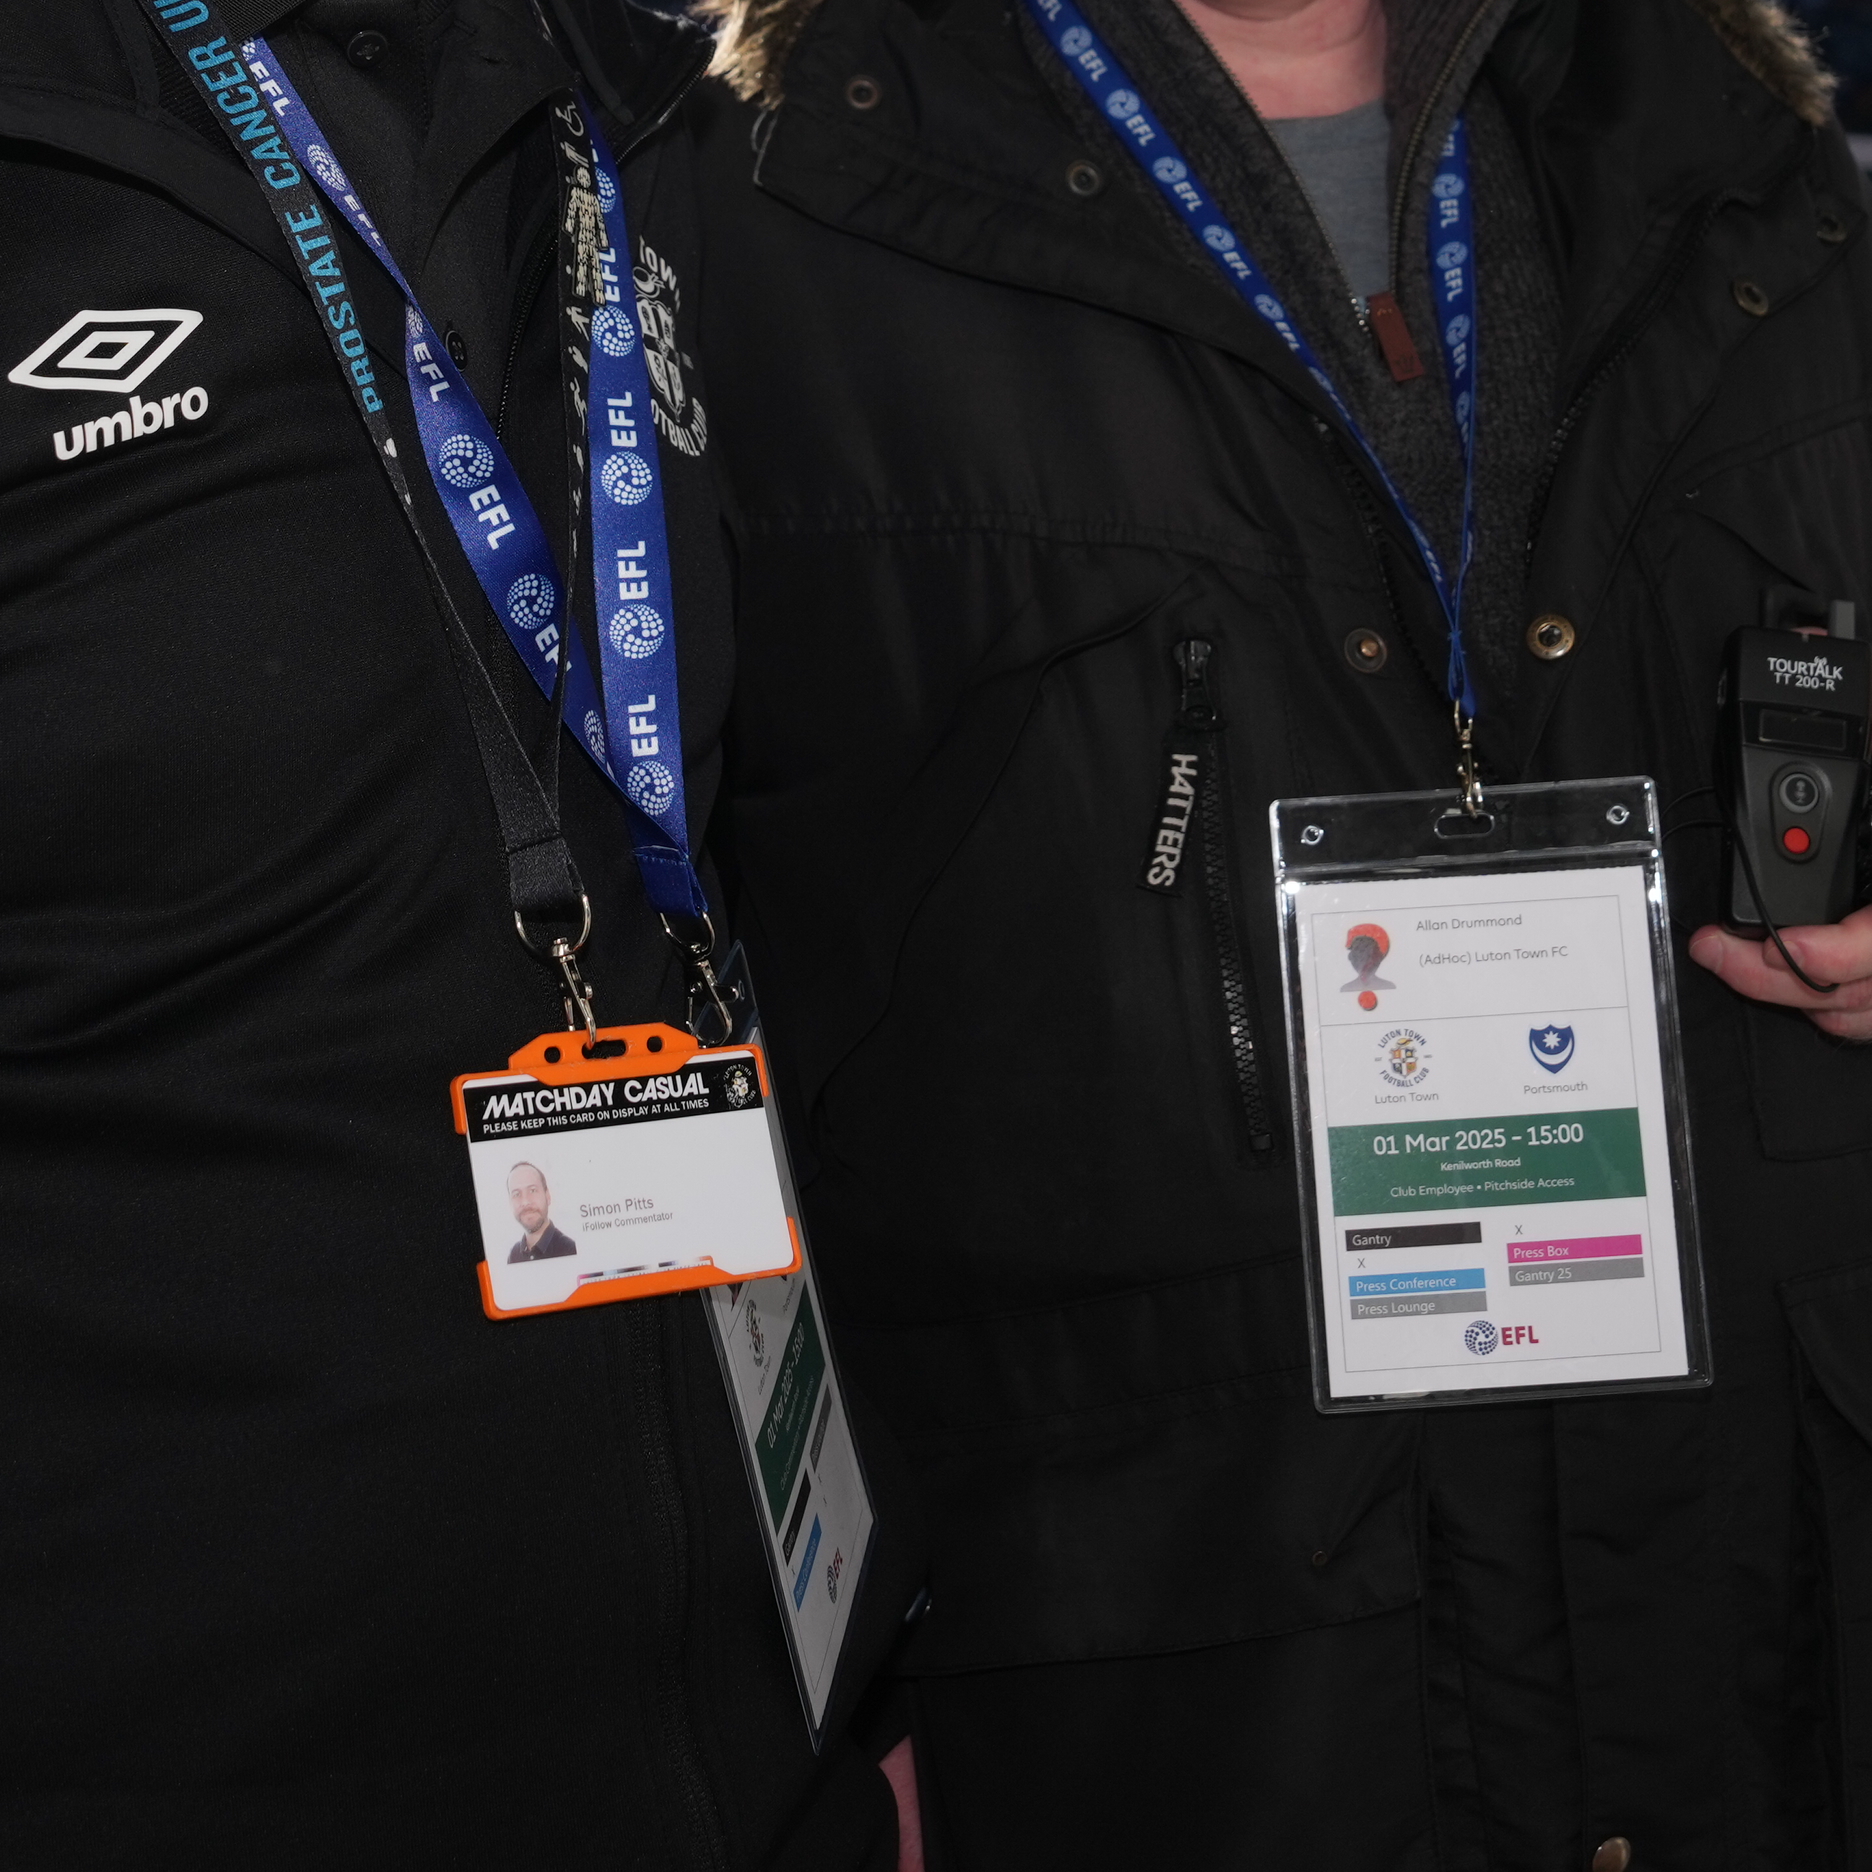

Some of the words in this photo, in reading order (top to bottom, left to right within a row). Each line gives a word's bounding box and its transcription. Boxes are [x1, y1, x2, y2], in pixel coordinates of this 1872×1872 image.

[1078, 48, 1108, 82] EFL
[247, 61, 291, 117] EFL
[187, 35, 302, 190] CANCER
[1125, 114, 1157, 147] EFL
[1173, 181, 1203, 212] EFL
[344, 194, 382, 247] EFL
[1439, 198, 1459, 229] EFL
[1222, 251, 1252, 280] EFL
[1444, 267, 1464, 302] EFL
[285, 203, 384, 413] PROSTATE
[1275, 321, 1300, 351] EFL
[412, 341, 451, 403] EFL
[53, 386, 209, 461] umbro
[607, 391, 638, 448] EFL
[468, 483, 516, 551] EFL
[617, 540, 650, 601] EFL
[535, 623, 572, 678] EF
[1767, 656, 1843, 681] TOURTALK
[1774, 672, 1792, 685] TT
[1795, 675, 1835, 691] 200-R
[628, 694, 660, 758] EFL
[1146, 753, 1199, 888] HATTERS
[1416, 918, 1448, 932] Allan
[1451, 914, 1523, 930] Drummond
[1419, 952, 1472, 968] (AdHoc)
[1475, 949, 1511, 963] Luton
[1513, 947, 1549, 960] Town
[1551, 946, 1569, 958] FC
[1378, 1029, 1402, 1048] LUTON
[1404, 1028, 1427, 1046] TOWN
[1379, 1069, 1414, 1088] FOOTBALL
[1413, 1067, 1430, 1084] CLUB
[1523, 1081, 1588, 1096] Portsmouth
[482, 1082, 616, 1120] MATCHDAY
[624, 1072, 710, 1103] CASUAL
[1374, 1094, 1406, 1104] Luton
[1408, 1092, 1439, 1102] Town
[483, 1121, 519, 1134] PLEASE
[520, 1118, 545, 1130] KEEP
[546, 1115, 568, 1127] THIS
[569, 1112, 595, 1124] CARD
[596, 1110, 610, 1121] ON
[612, 1105, 650, 1119] DISPLAY
[651, 1104, 661, 1114] AT
[663, 1102, 680, 1113] ALL
[681, 1098, 710, 1111] TIMES
[1373, 1135, 1399, 1156] 01
[1405, 1133, 1450, 1154] Mar
[1454, 1128, 1507, 1151] 2025
[1526, 1123, 1584, 1145] 15:00
[1440, 1158, 1493, 1172] Kenilworth
[1494, 1157, 1521, 1169] Road
[1390, 1184, 1417, 1198] Club
[1419, 1182, 1474, 1198] Employee
[1484, 1177, 1536, 1192] Pitchside
[1537, 1176, 1575, 1188] Access
[579, 1202, 621, 1218] Simon
[624, 1196, 654, 1212] Pitts
[582, 1220, 612, 1232] iFollow
[614, 1211, 674, 1227] Commentator
[1352, 1233, 1392, 1249] Gantry
[1515, 1225, 1523, 1235] X
[1357, 1258, 1366, 1269] X
[1513, 1247, 1544, 1259] Press
[1547, 1245, 1569, 1257] Box
[1356, 1281, 1387, 1292] Press
[1390, 1276, 1456, 1290] Conference
[1515, 1270, 1555, 1283] Gantry
[1557, 1268, 1572, 1279] 25
[1358, 1303, 1388, 1315] Press
[1391, 1301, 1436, 1314] Lounge
[1501, 1325, 1539, 1346] EFL
